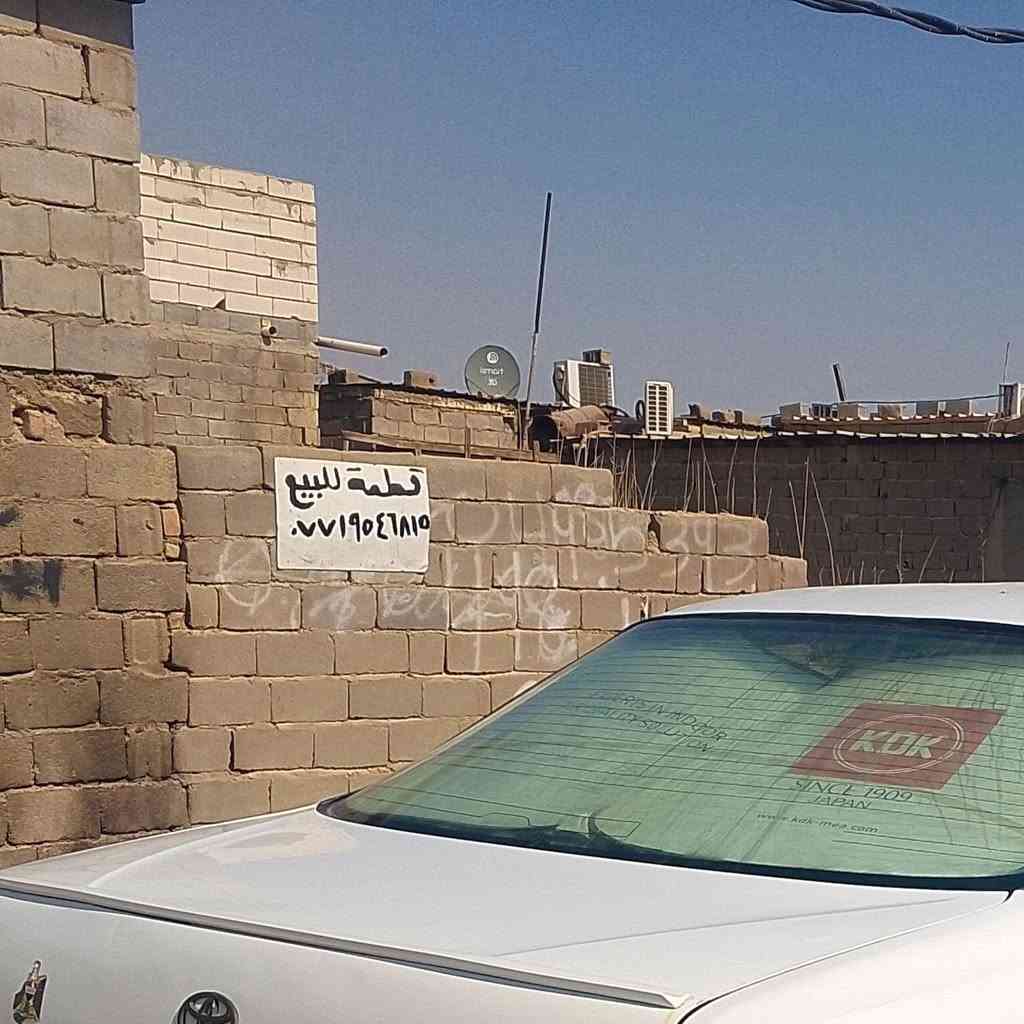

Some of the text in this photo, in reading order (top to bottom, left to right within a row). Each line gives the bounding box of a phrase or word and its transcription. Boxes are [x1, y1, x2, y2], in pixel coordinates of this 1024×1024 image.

[285, 467, 424, 509] قطعة للبيع
[849, 729, 945, 759] KDK
[814, 794, 872, 810] JAPAN
[863, 785, 913, 802] 1909
